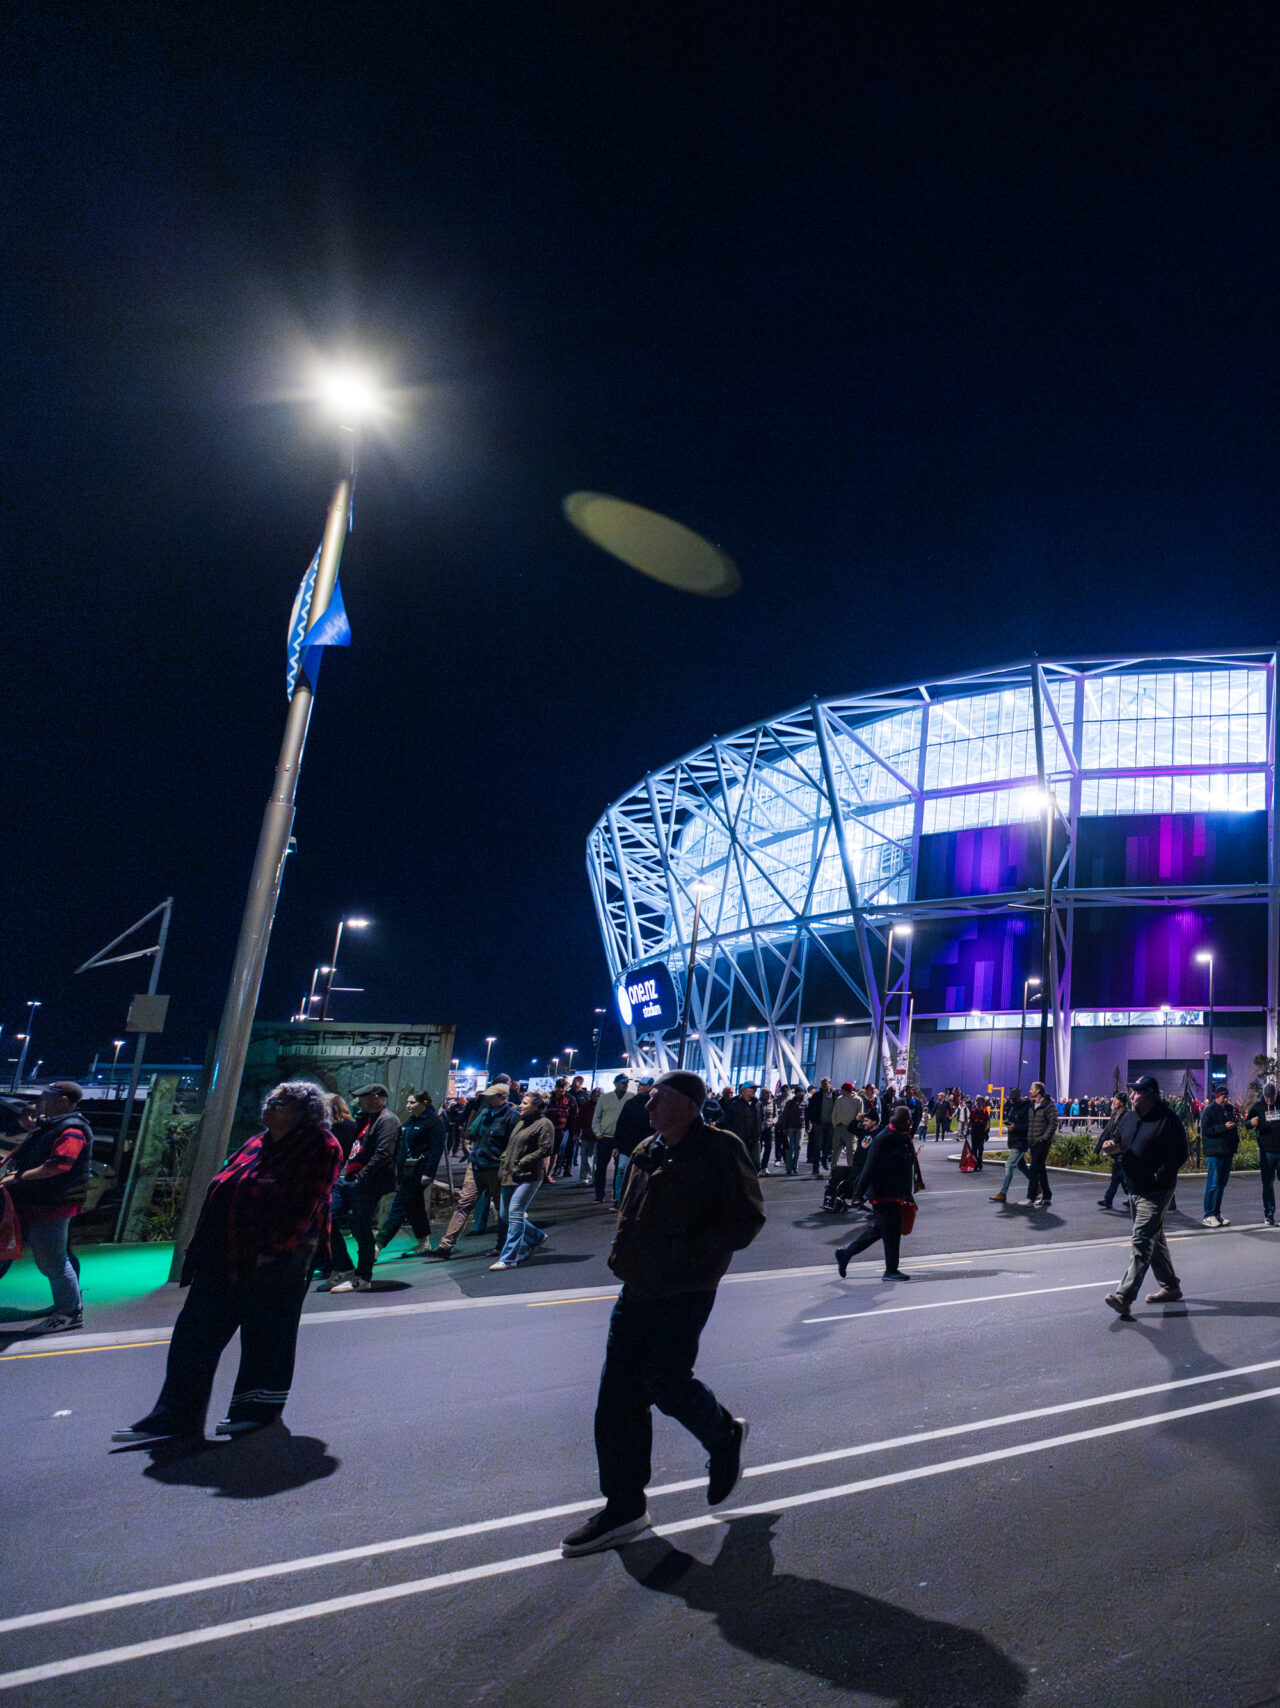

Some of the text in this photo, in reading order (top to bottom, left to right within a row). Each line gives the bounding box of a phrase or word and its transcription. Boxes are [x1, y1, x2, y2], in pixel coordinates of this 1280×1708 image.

[628, 979, 658, 1005] one.nz
[643, 1002, 662, 1018] stadium
[347, 1046, 424, 1056] 1732932
